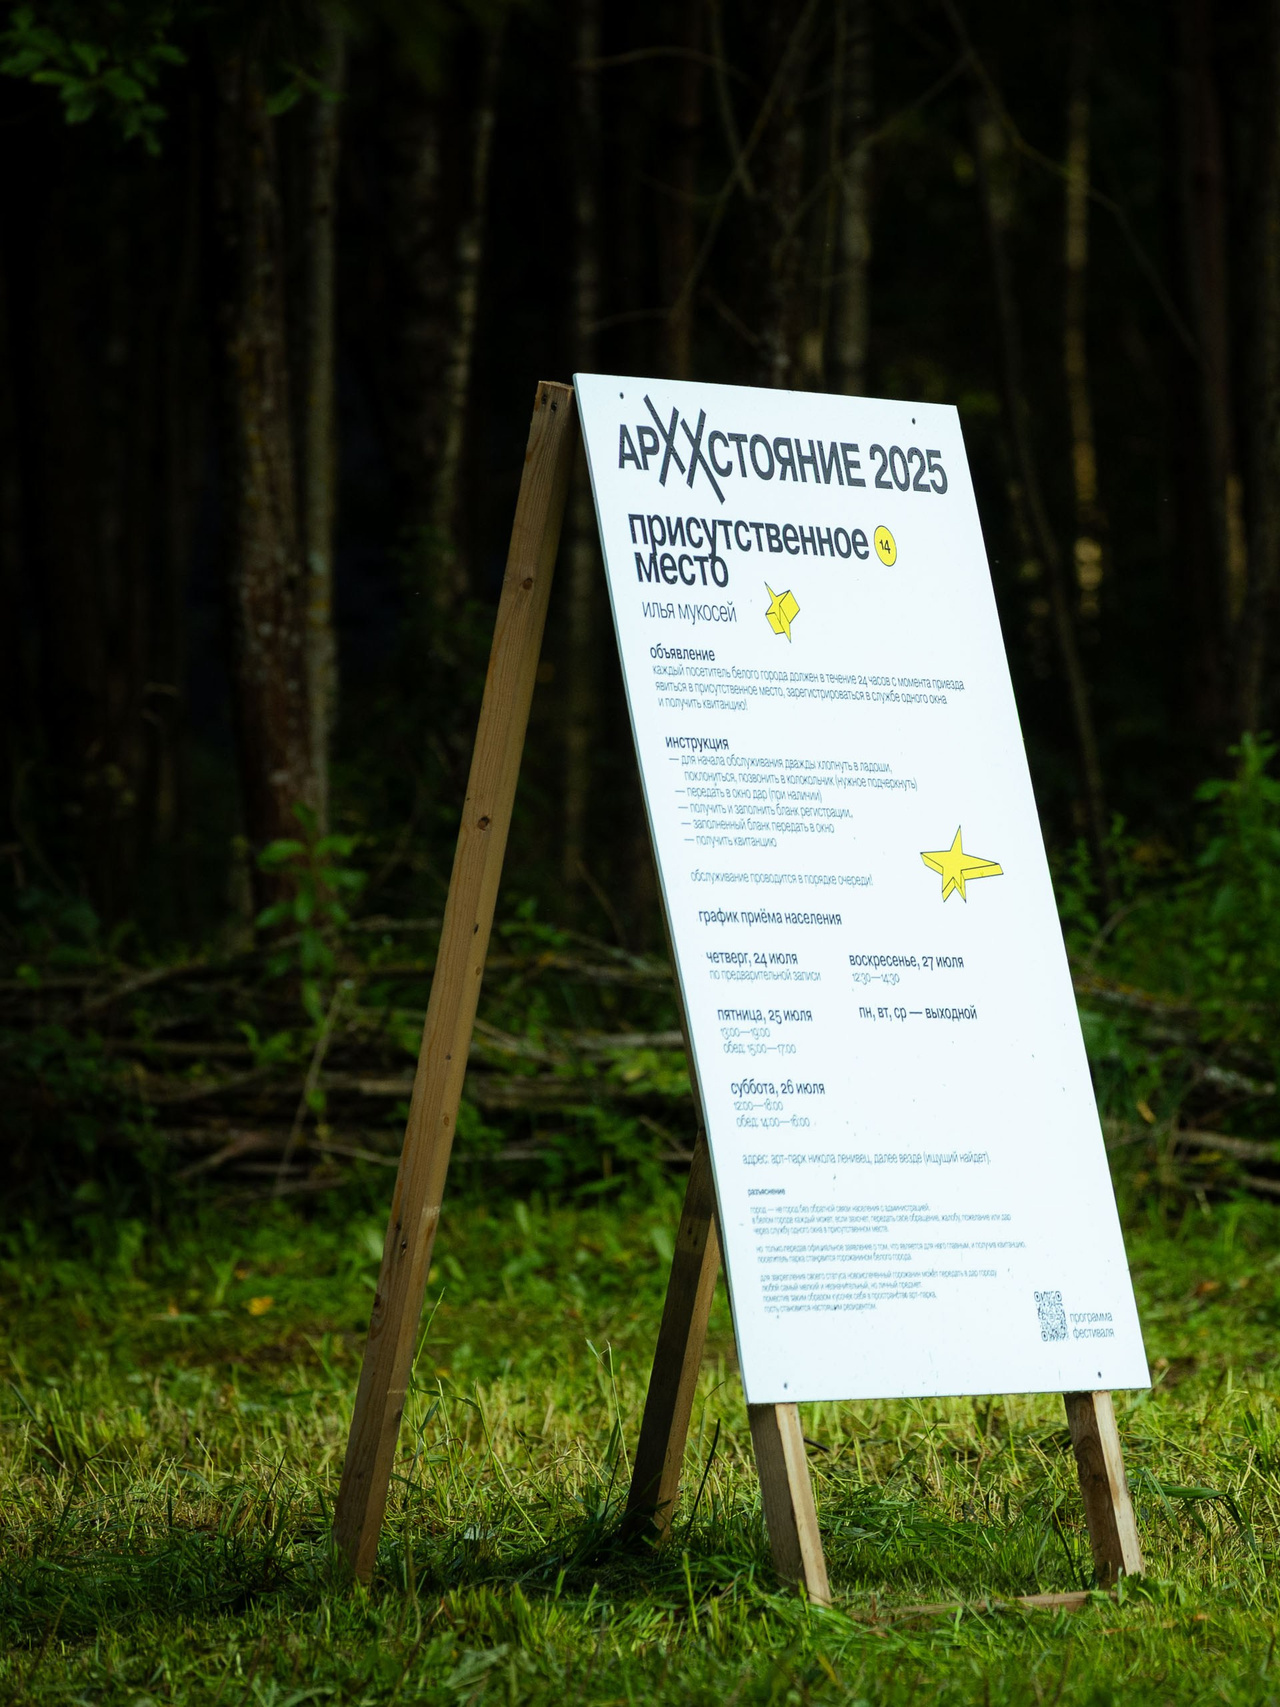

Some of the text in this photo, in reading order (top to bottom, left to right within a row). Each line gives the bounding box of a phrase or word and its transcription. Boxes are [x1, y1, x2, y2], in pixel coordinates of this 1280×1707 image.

[869, 443, 949, 495] 2025
[628, 513, 870, 560] присутственное
[879, 539, 891, 554] 14
[634, 551, 729, 588] место
[641, 600, 737, 625] илья мукосей
[649, 642, 715, 661] объявление
[652, 663, 965, 691] каждый посетитель белого города должен в течение 24 часов с момента приезда
[654, 681, 947, 704] явиться в присутственное место, зарегистрироваться в службе одного окна
[657, 697, 664, 706] и
[664, 697, 701, 710] получить
[664, 736, 729, 752] инструкция
[681, 754, 696, 766] для
[696, 755, 725, 766] начала
[725, 753, 784, 769] обслуживания
[784, 758, 816, 770] дважды
[816, 760, 853, 773] хлопнуть
[852, 761, 859, 771] в
[738, 772, 779, 783] позвонить
[779, 774, 785, 783] в
[785, 774, 834, 785] колокольчик
[834, 774, 866, 789] (нужное
[867, 777, 917, 791] подчеркнуть)
[686, 786, 822, 802] передать в окно дар (при наличии)
[689, 803, 726, 816] получить
[728, 805, 732, 813] и
[734, 804, 775, 815] заполнить
[775, 803, 799, 815] бланк
[692, 817, 834, 833] заполненный бланк передать в окно
[695, 835, 777, 847] получить квитанцию
[690, 868, 873, 886] обслуживание проводится в порядке очереди!
[698, 907, 842, 927] график приёма населения
[705, 951, 798, 968] четверг, 24 июля
[848, 954, 964, 971] воскресенье, 27 июля
[709, 968, 821, 981] по предварительной записи
[716, 1008, 813, 1024] пятница, 25 июля
[858, 1006, 876, 1021] пн,
[876, 1006, 892, 1021] вт,
[893, 1006, 907, 1022] ср
[924, 1004, 977, 1022] выходной
[730, 1077, 825, 1098] суббота, 26 июля
[1069, 1312, 1113, 1325] программа
[1073, 1327, 1115, 1341] фестиваля
